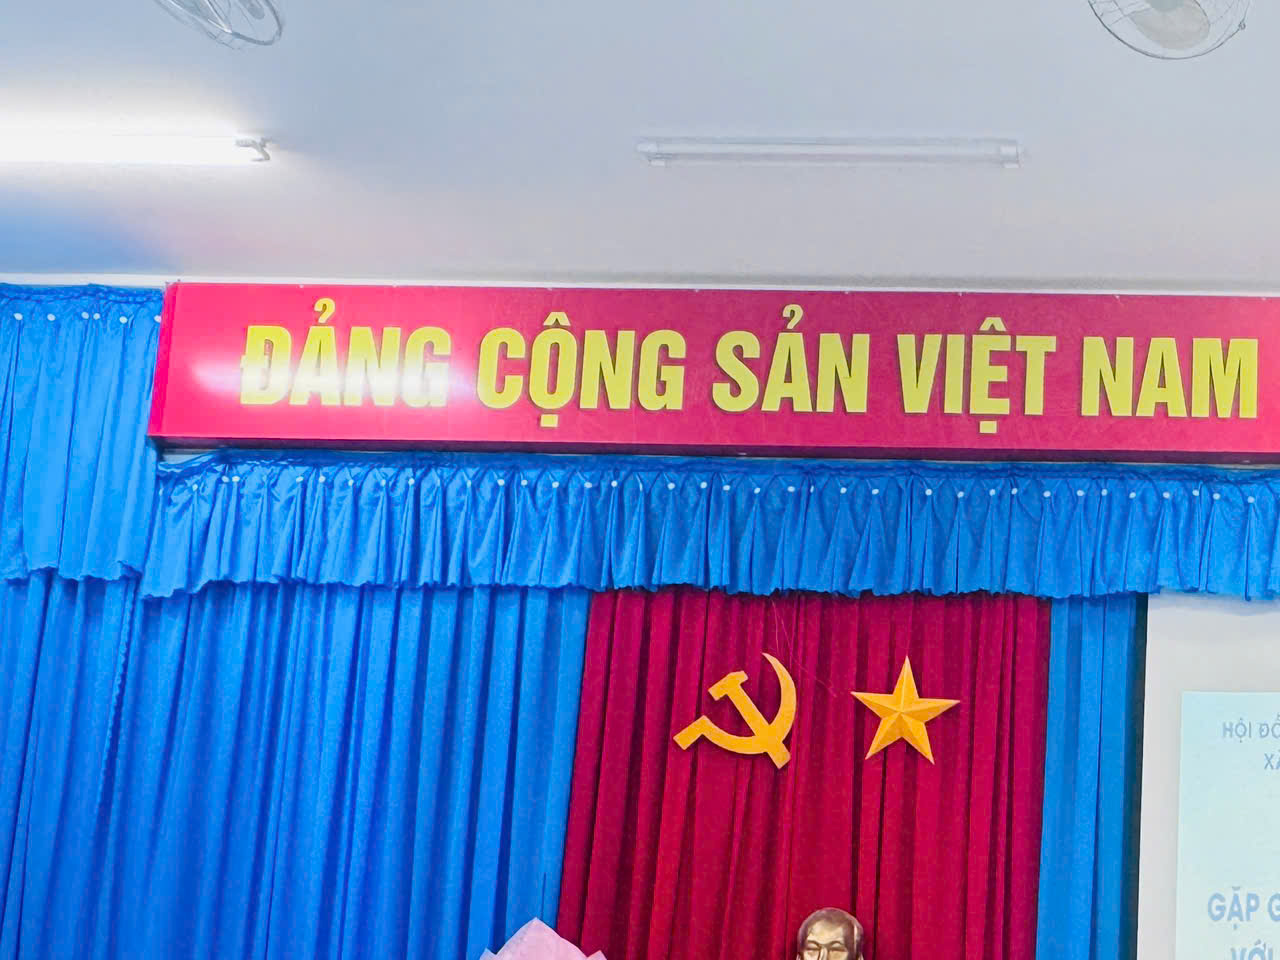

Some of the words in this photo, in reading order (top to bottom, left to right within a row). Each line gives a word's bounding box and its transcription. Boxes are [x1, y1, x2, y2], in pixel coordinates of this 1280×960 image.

[240, 297, 451, 406] ĐẢNG
[476, 312, 686, 428] CỘNG
[712, 304, 869, 413] SẢN
[897, 316, 1056, 434] VIỆT
[1080, 336, 1258, 419] NAM
[1222, 717, 1252, 743] HỘI
[1207, 886, 1260, 930] GẶP
